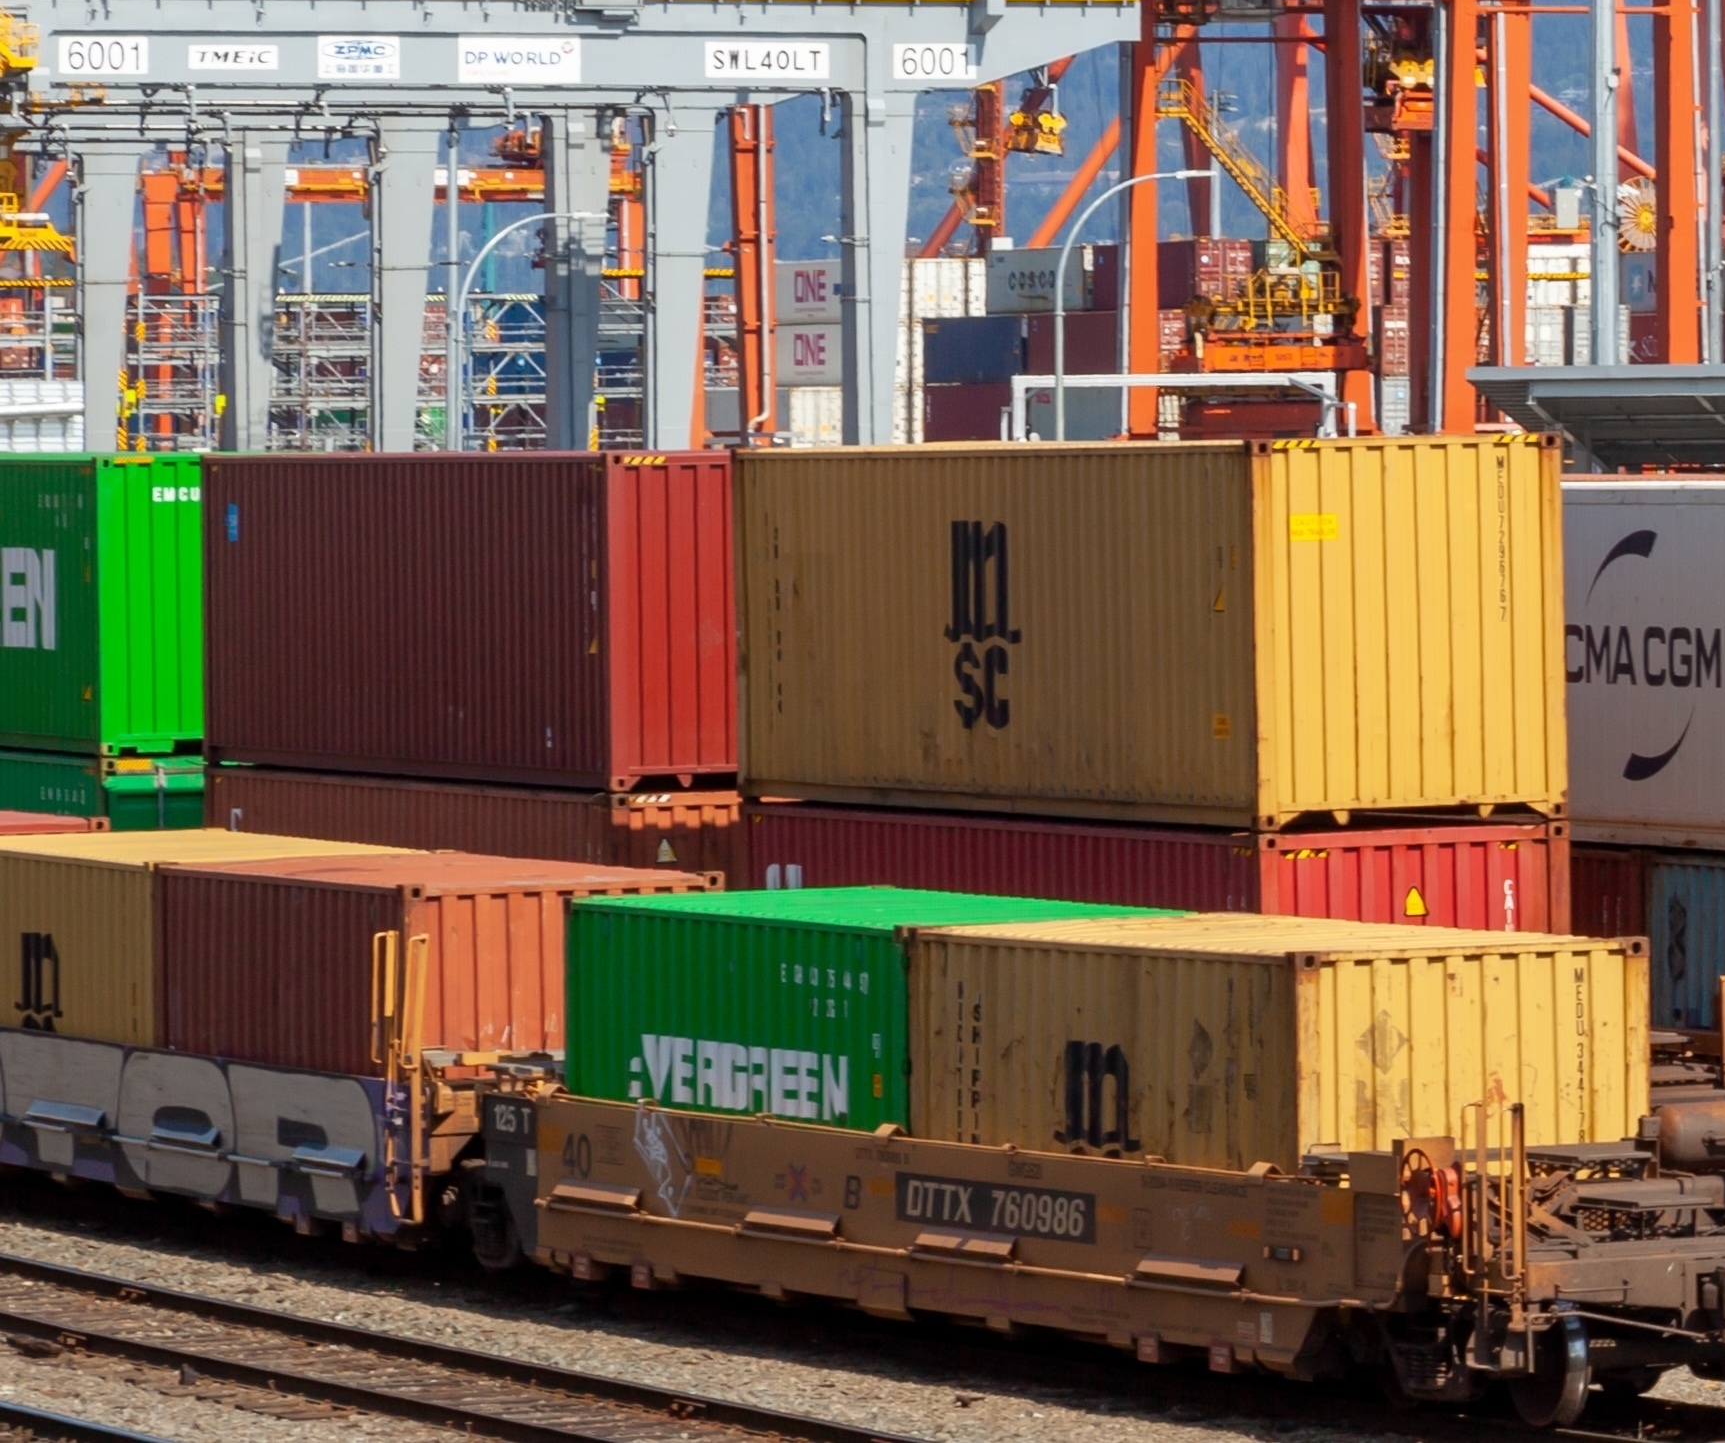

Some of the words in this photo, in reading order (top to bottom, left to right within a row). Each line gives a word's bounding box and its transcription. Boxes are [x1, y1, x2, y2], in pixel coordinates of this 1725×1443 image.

[68, 41, 140, 71] 6001
[333, 45, 386, 56] ZPMC
[464, 50, 489, 65] DP
[492, 50, 561, 66] WORLD
[712, 49, 821, 71] SWL40LT
[902, 46, 972, 76] 6001
[794, 269, 827, 303] ONE
[794, 333, 827, 366] ONE
[152, 485, 201, 503] EMCU
[1563, 623, 1637, 687] CMA
[1643, 625, 1723, 689] CGM
[521, 1108, 533, 1135] T
[562, 1132, 591, 1181] 40
[844, 1174, 861, 1210] B
[905, 1179, 972, 1224] DTTX
[991, 1189, 1085, 1237] 760986
